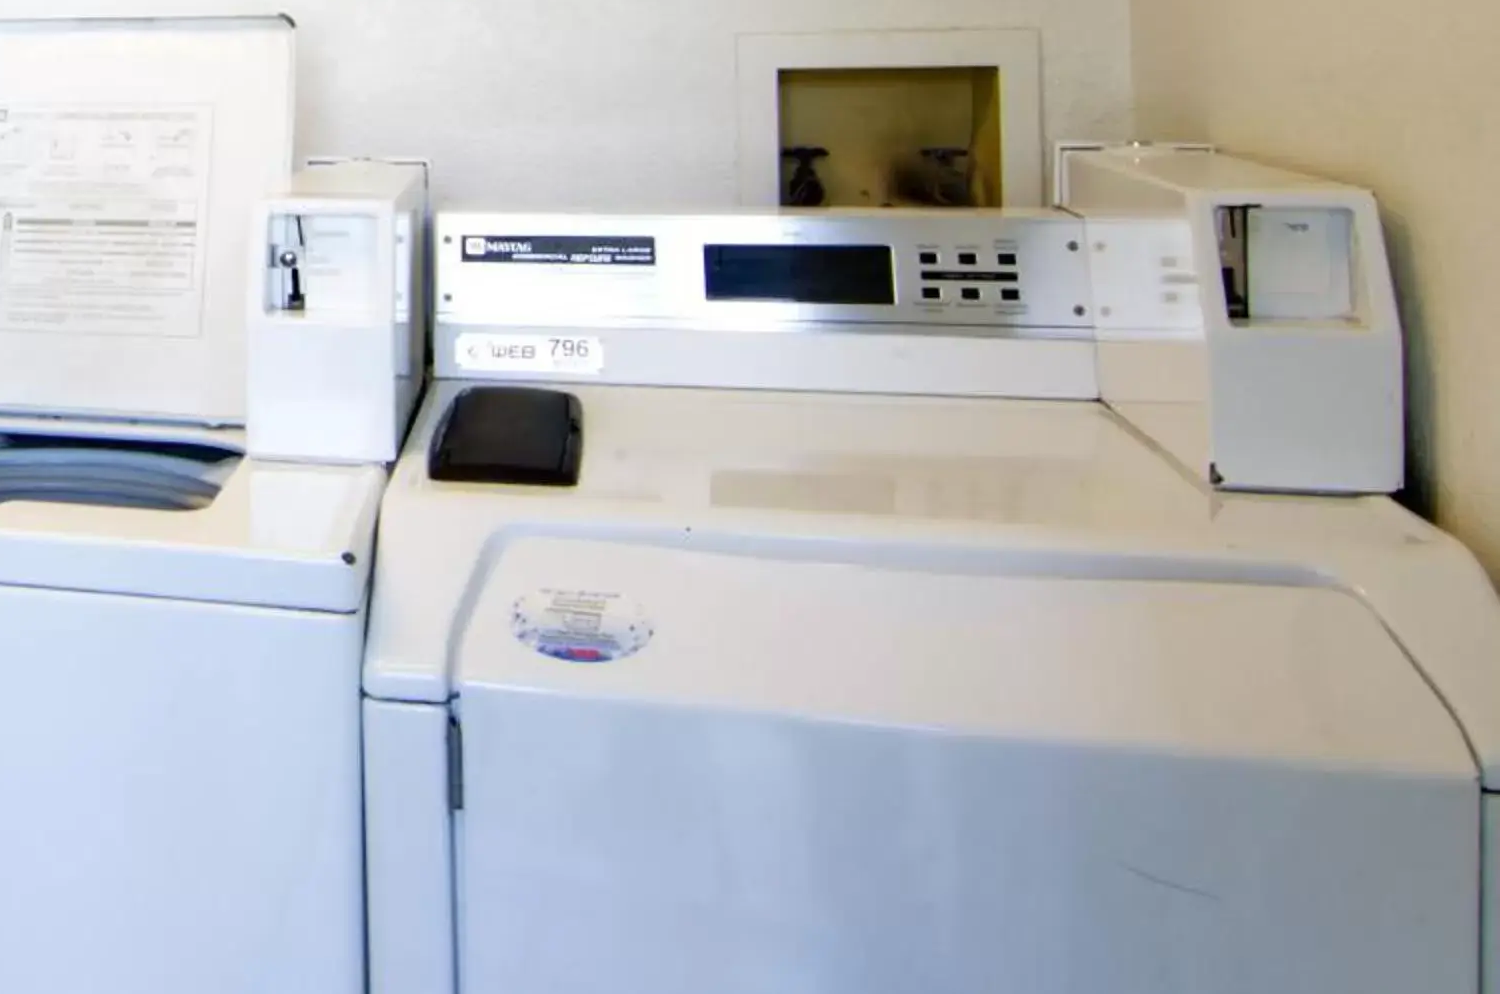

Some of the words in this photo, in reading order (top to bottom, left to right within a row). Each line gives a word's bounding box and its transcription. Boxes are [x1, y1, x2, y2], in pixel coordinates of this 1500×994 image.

[486, 241, 532, 253] MAYTAG
[491, 344, 537, 359] WEB
[548, 338, 589, 358] 796
